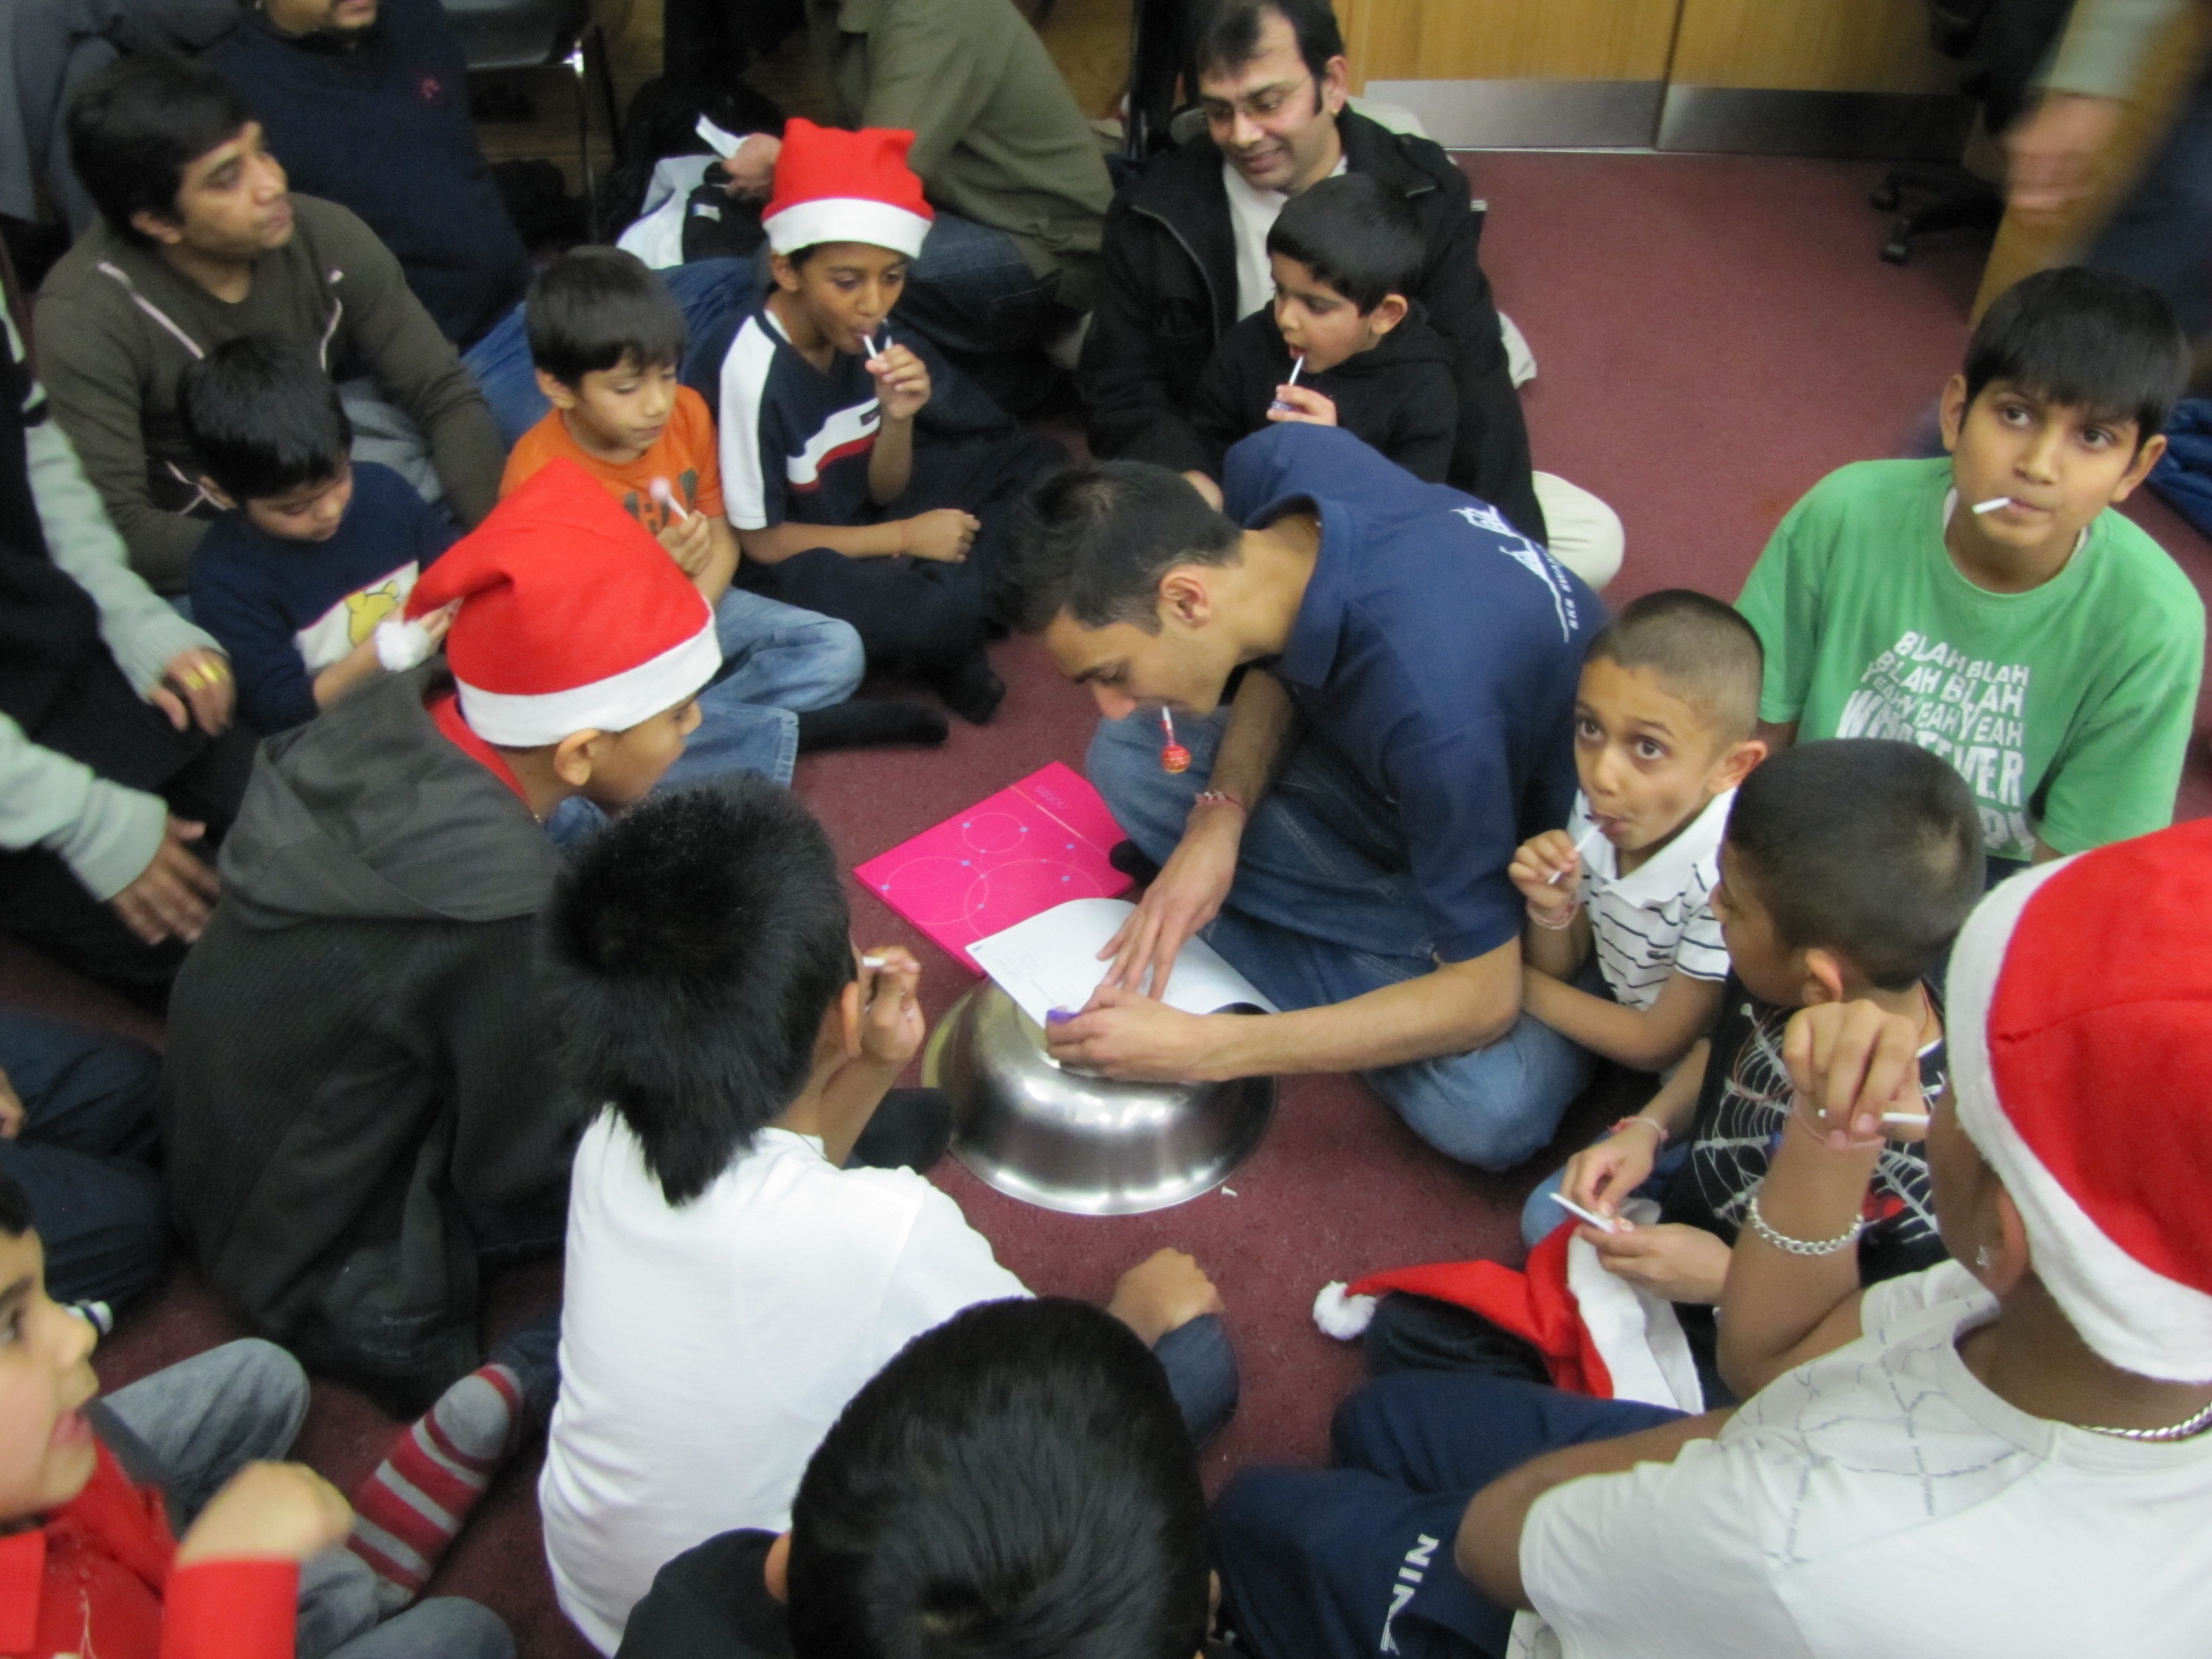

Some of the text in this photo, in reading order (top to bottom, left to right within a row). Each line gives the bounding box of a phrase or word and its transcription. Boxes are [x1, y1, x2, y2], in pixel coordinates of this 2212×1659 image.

[1875, 650, 2025, 717] BLAH BLAH
[1893, 630, 2031, 686] BLAH BLAH
[1835, 689, 2024, 807] WHVER
[1898, 695, 1962, 736] YEAH
[1957, 699, 2023, 748] YEAH
